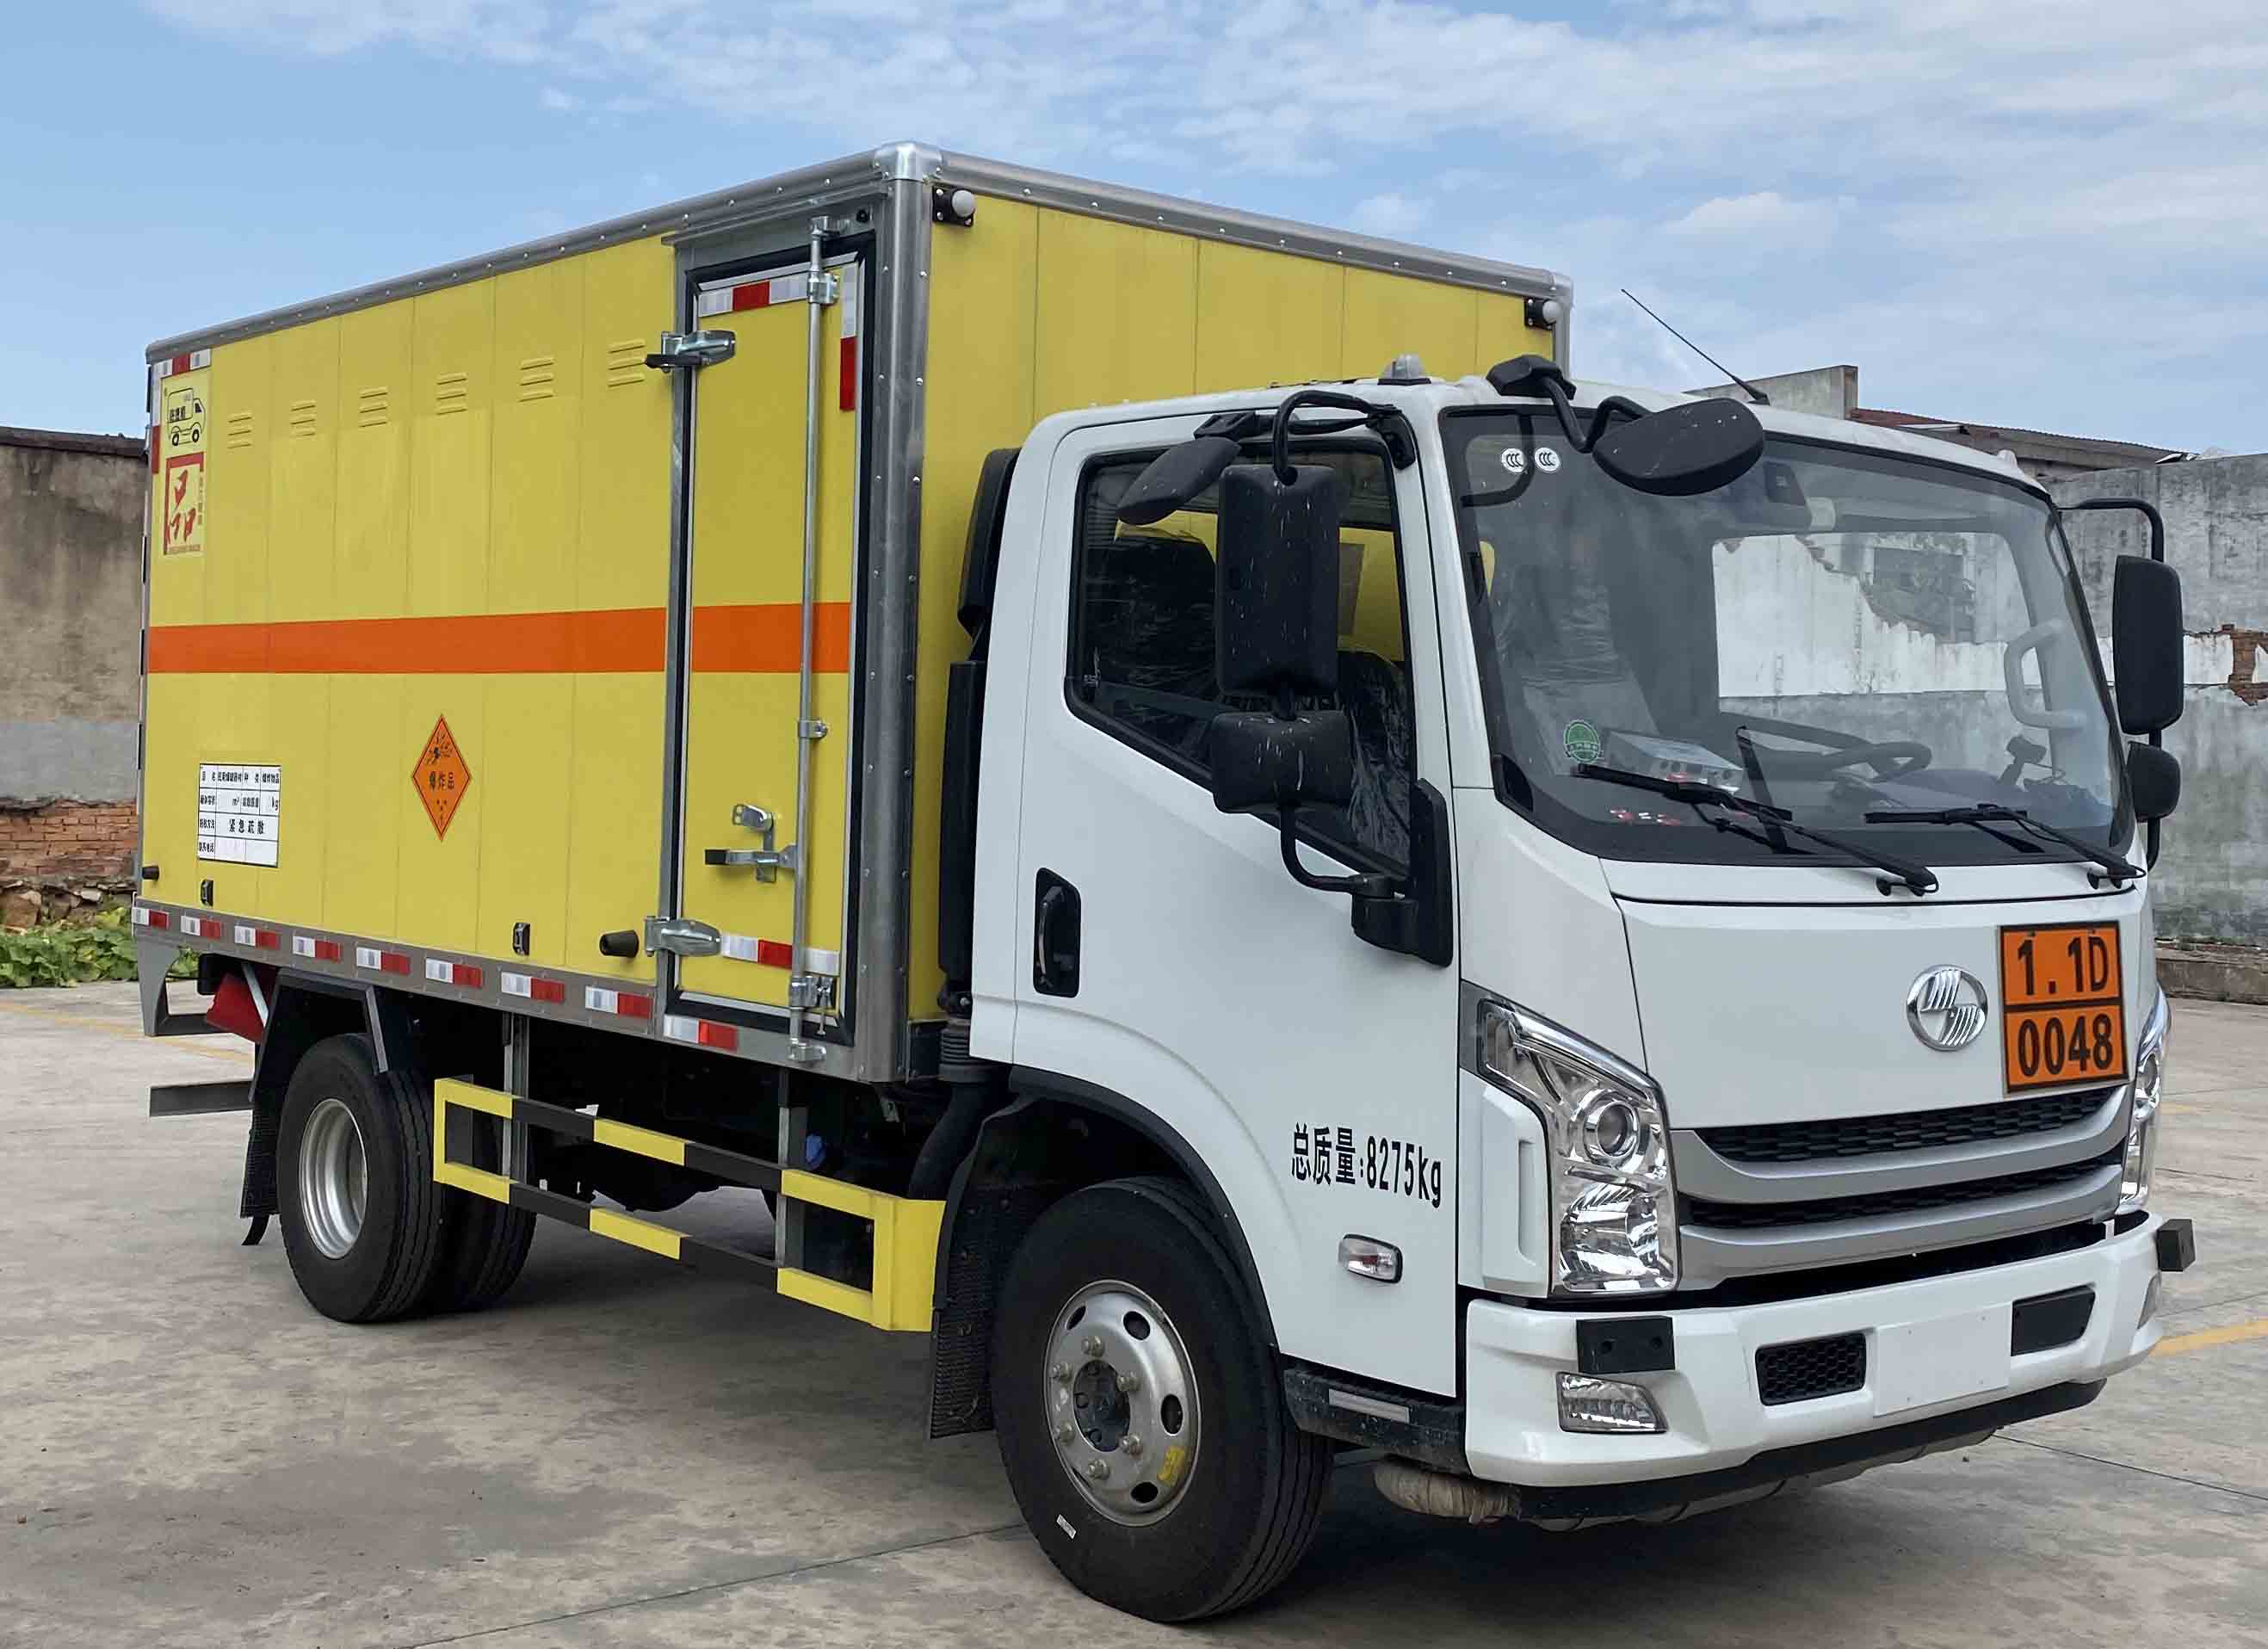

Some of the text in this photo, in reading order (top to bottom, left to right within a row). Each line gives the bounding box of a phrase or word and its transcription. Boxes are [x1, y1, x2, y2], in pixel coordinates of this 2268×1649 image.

[229, 818, 264, 835] 紧急疏散
[2018, 1013, 2113, 1077] 0048
